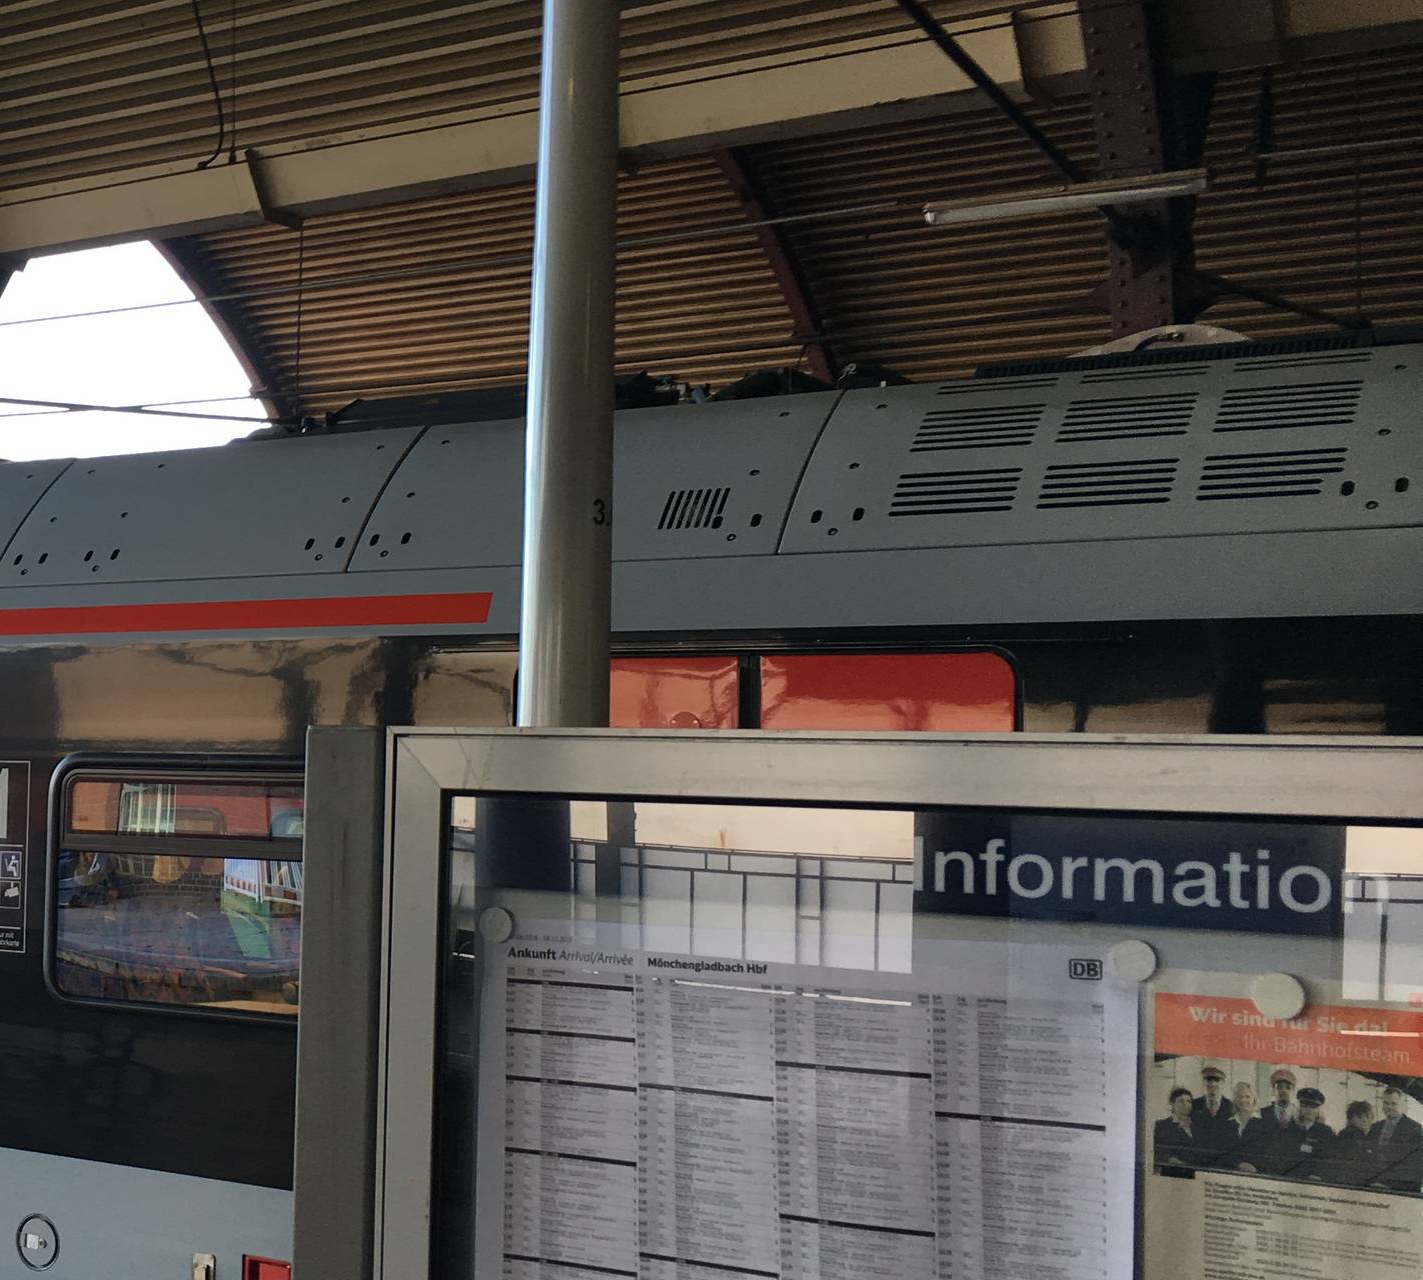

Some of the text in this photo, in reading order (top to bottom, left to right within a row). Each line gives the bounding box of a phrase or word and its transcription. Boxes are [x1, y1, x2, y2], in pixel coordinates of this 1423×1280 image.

[507, 946, 557, 961] Ankunft
[647, 957, 768, 975] Mönchengladbach Hbf
[1073, 962, 1099, 977] DB
[1188, 1006, 1227, 1024] Wir
[1316, 1016, 1350, 1033] Sie
